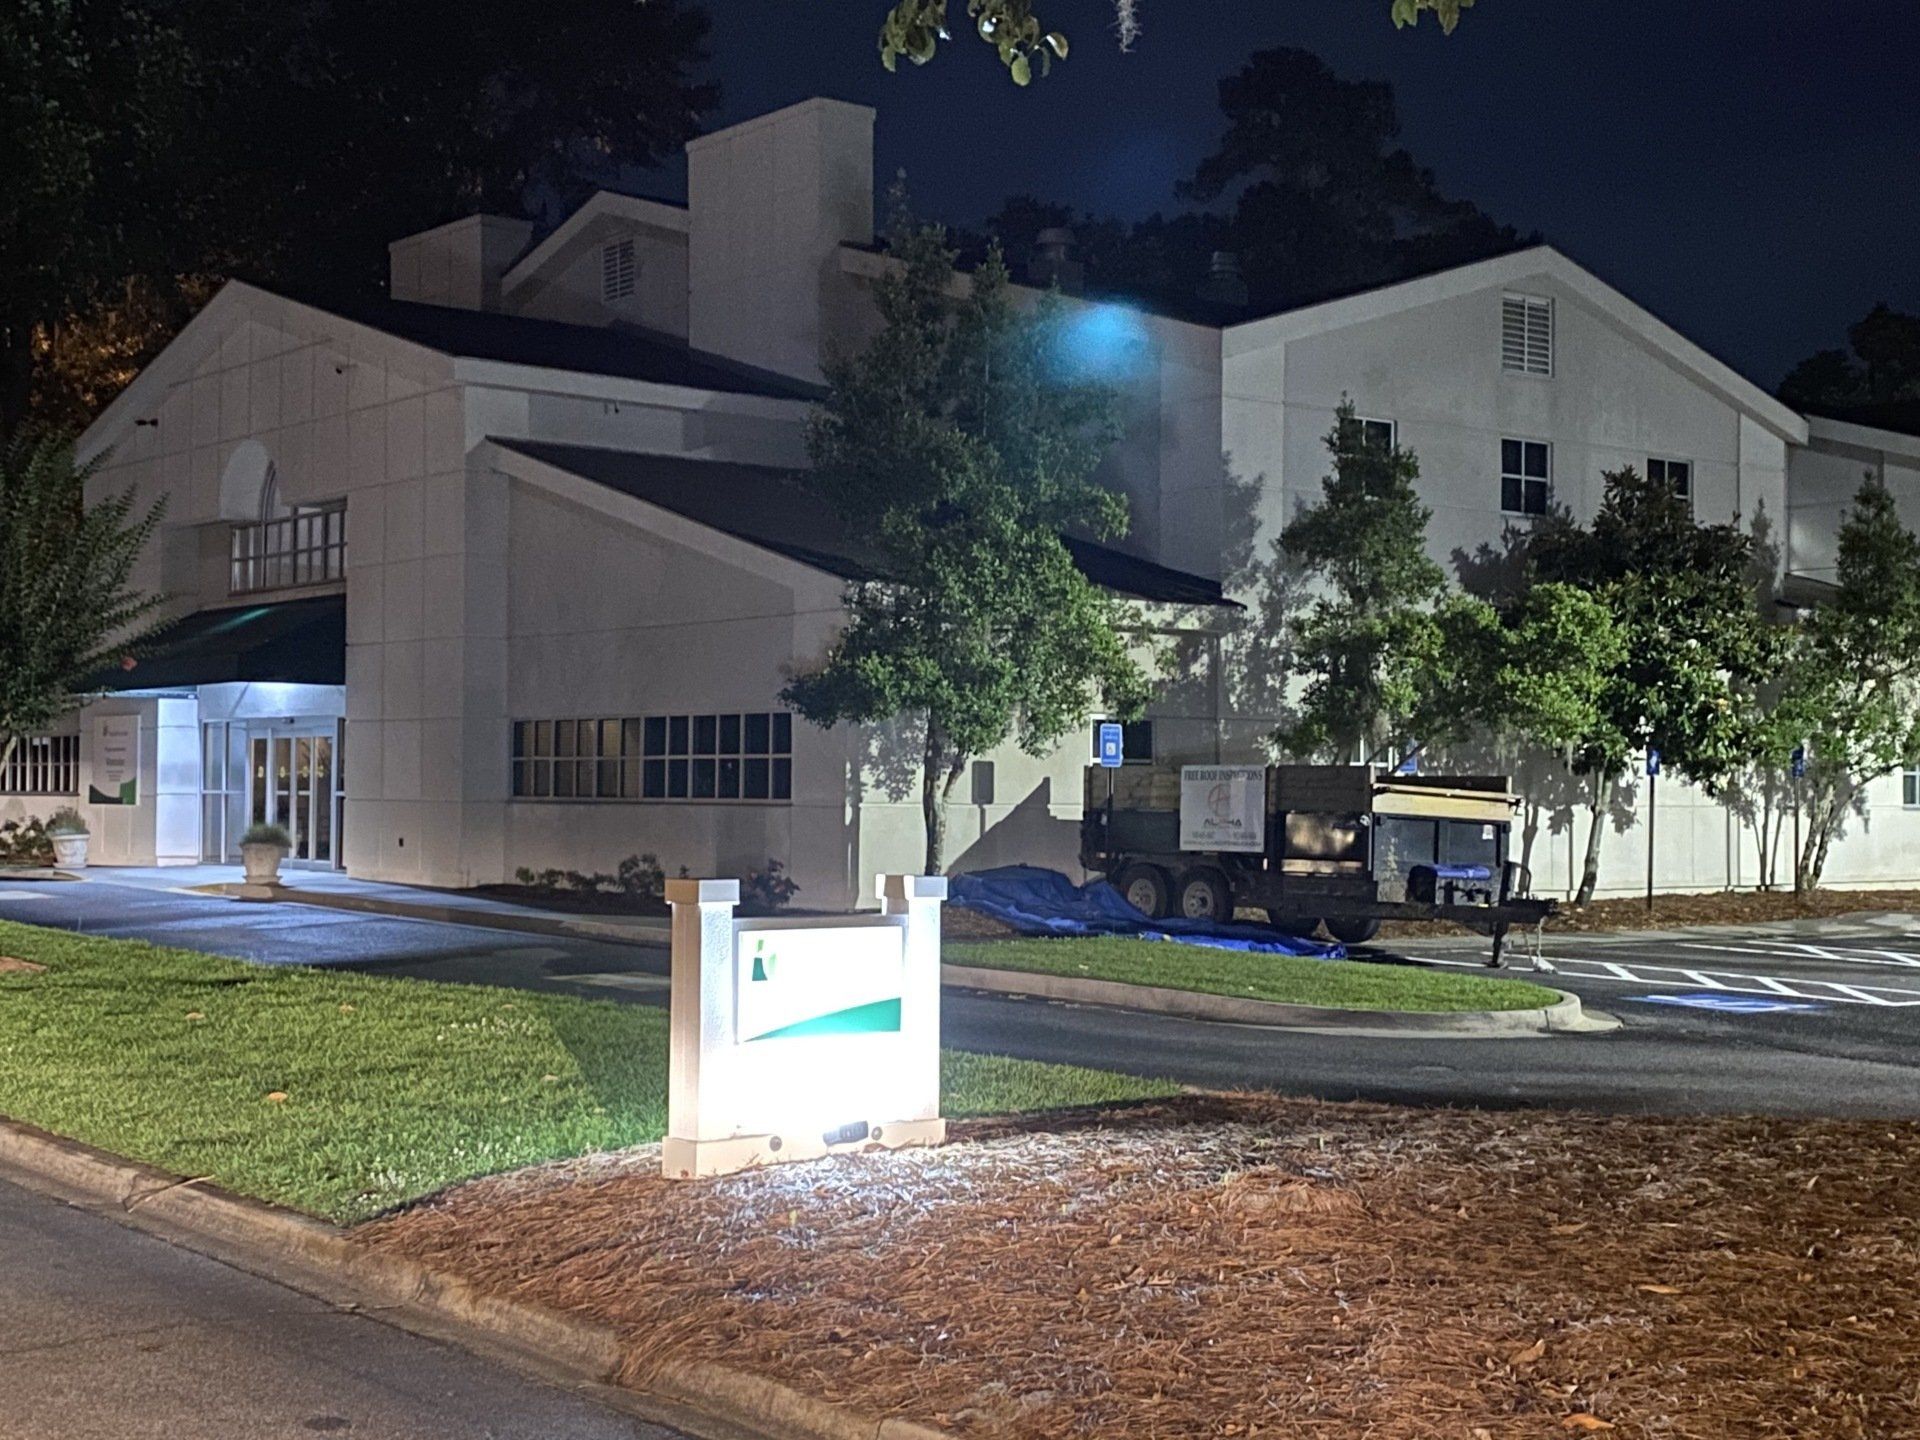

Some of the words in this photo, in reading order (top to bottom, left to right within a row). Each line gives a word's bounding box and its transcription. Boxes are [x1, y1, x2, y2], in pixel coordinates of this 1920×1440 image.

[1184, 770, 1199, 781] FREE
[1200, 770, 1217, 781] ROOF
[1204, 818, 1242, 828] ALHA
